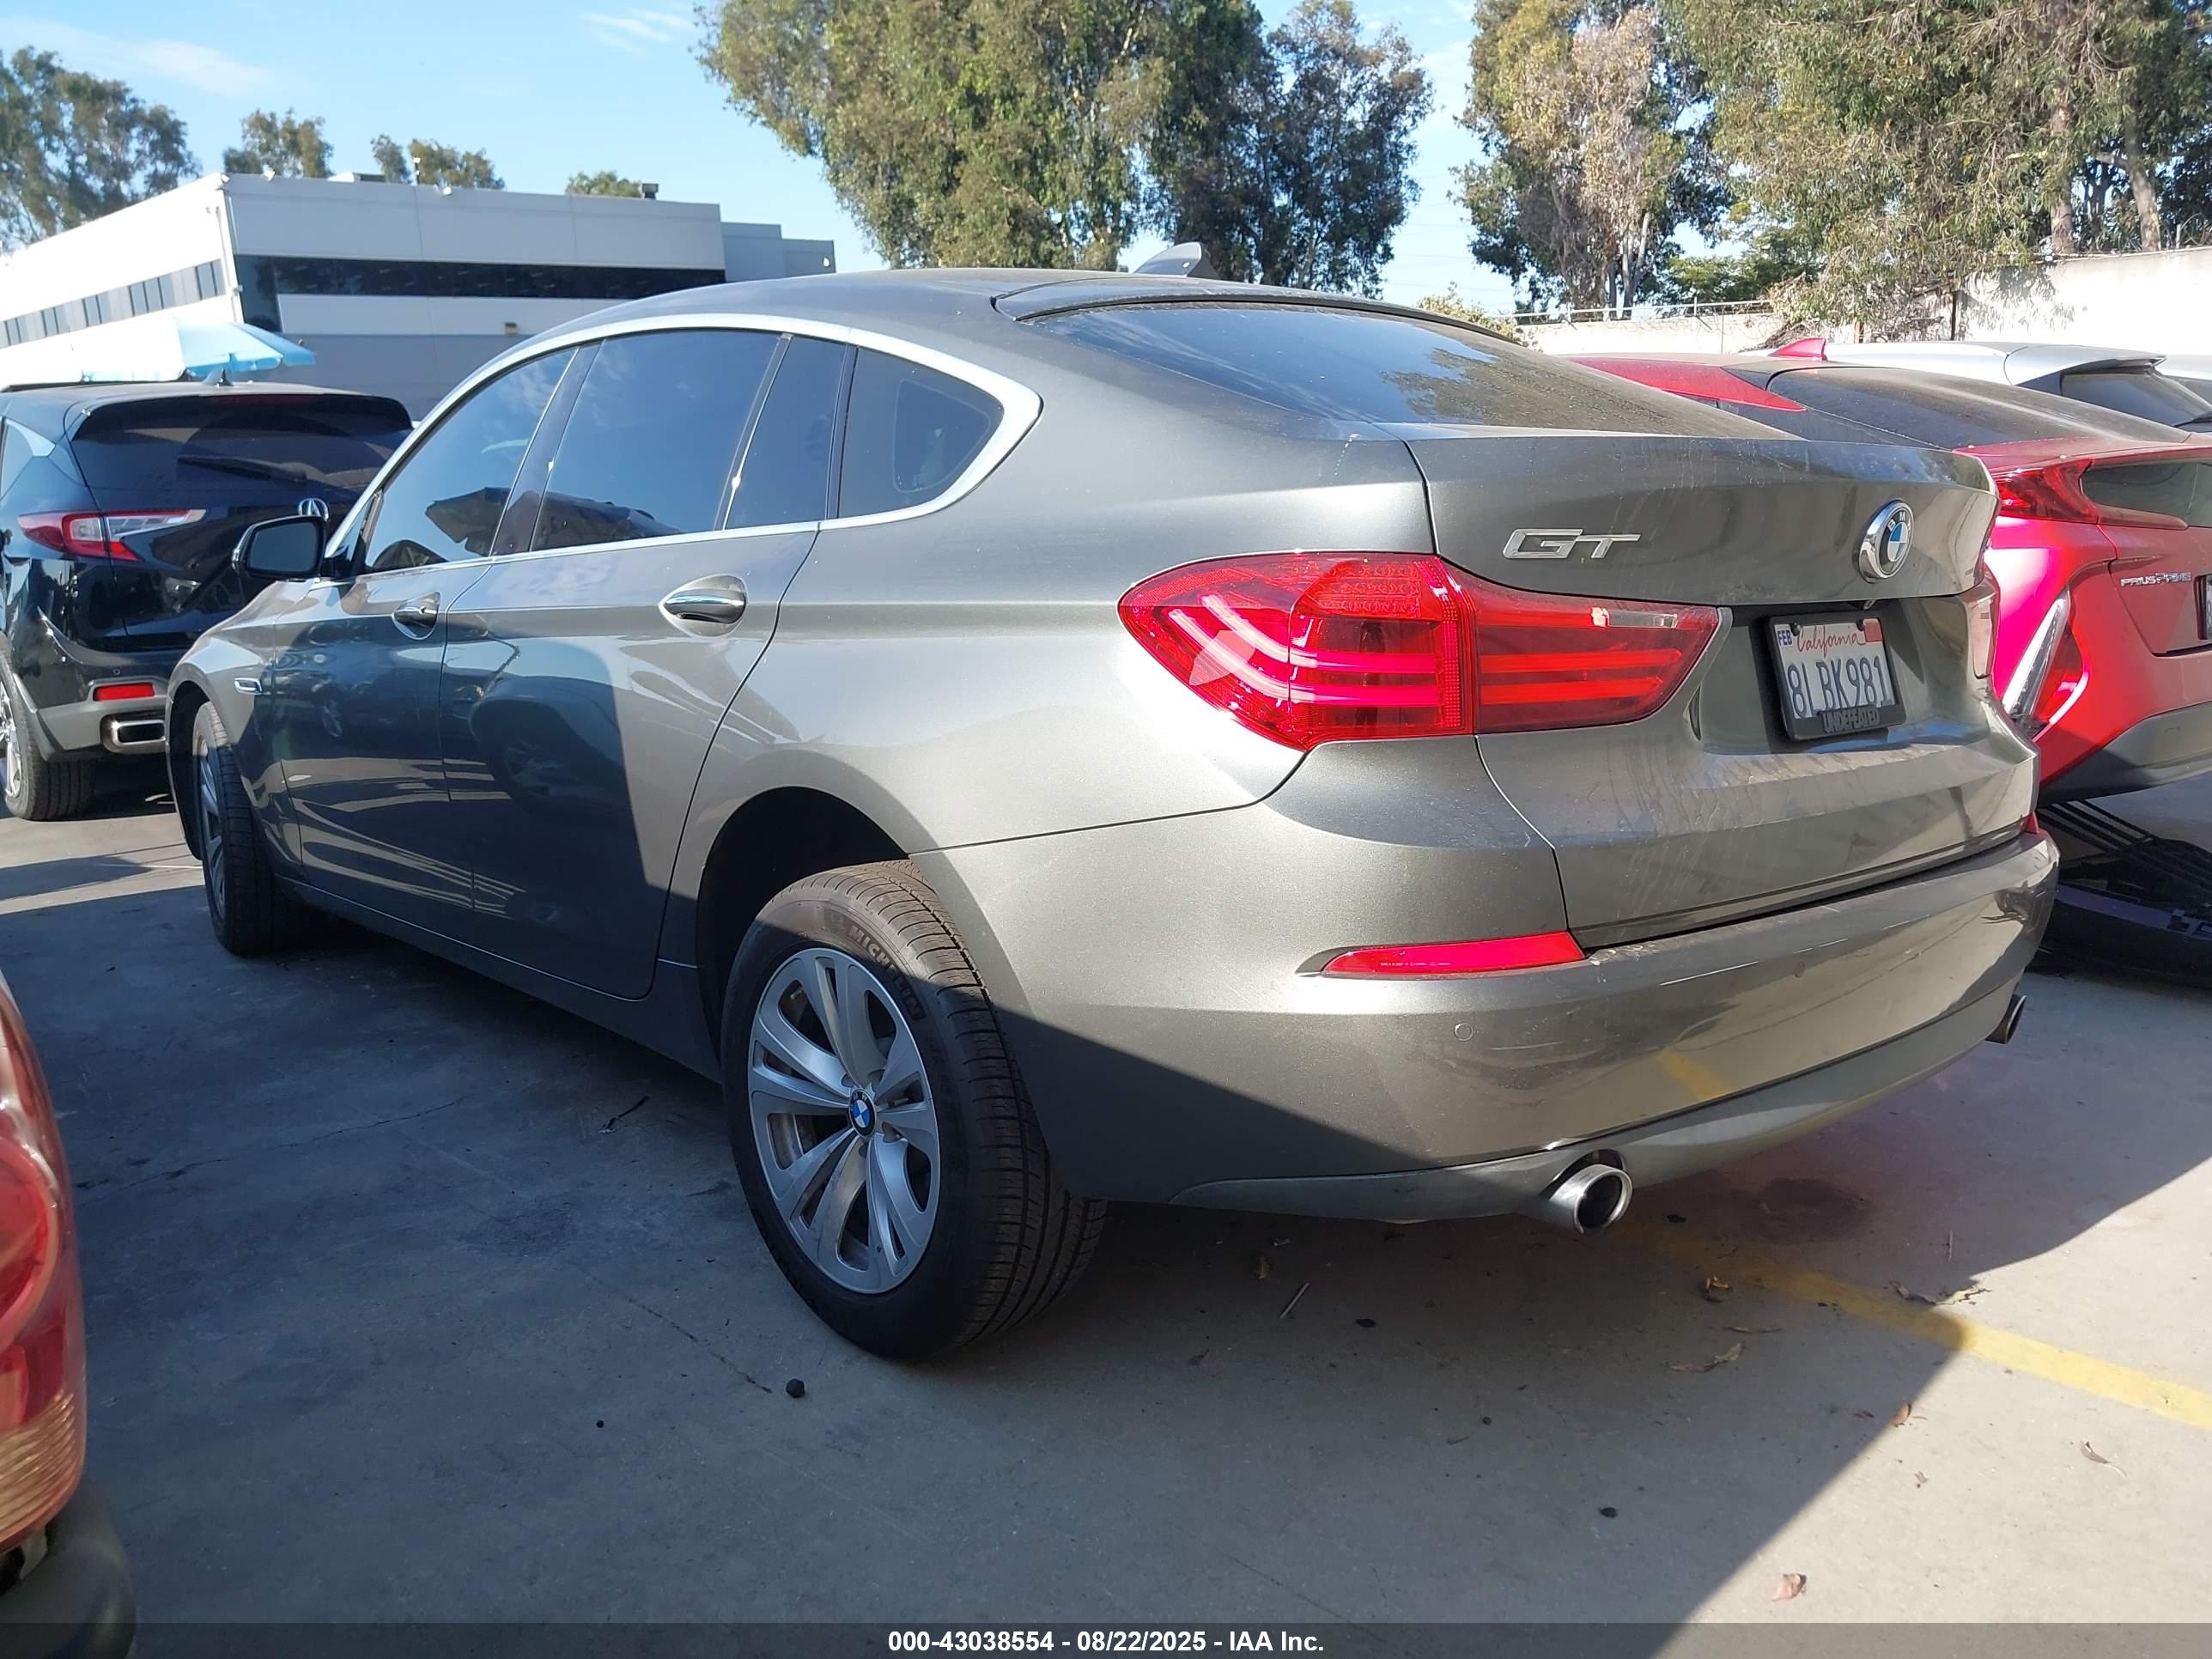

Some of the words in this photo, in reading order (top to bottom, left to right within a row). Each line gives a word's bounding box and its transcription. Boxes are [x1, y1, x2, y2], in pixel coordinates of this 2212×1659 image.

[1503, 528, 1642, 559] GT
[2120, 576, 2156, 586] PRIUS
[1777, 630, 1793, 647] FEB
[1797, 625, 1868, 658] California
[849, 925, 926, 1019] MICHELIN
